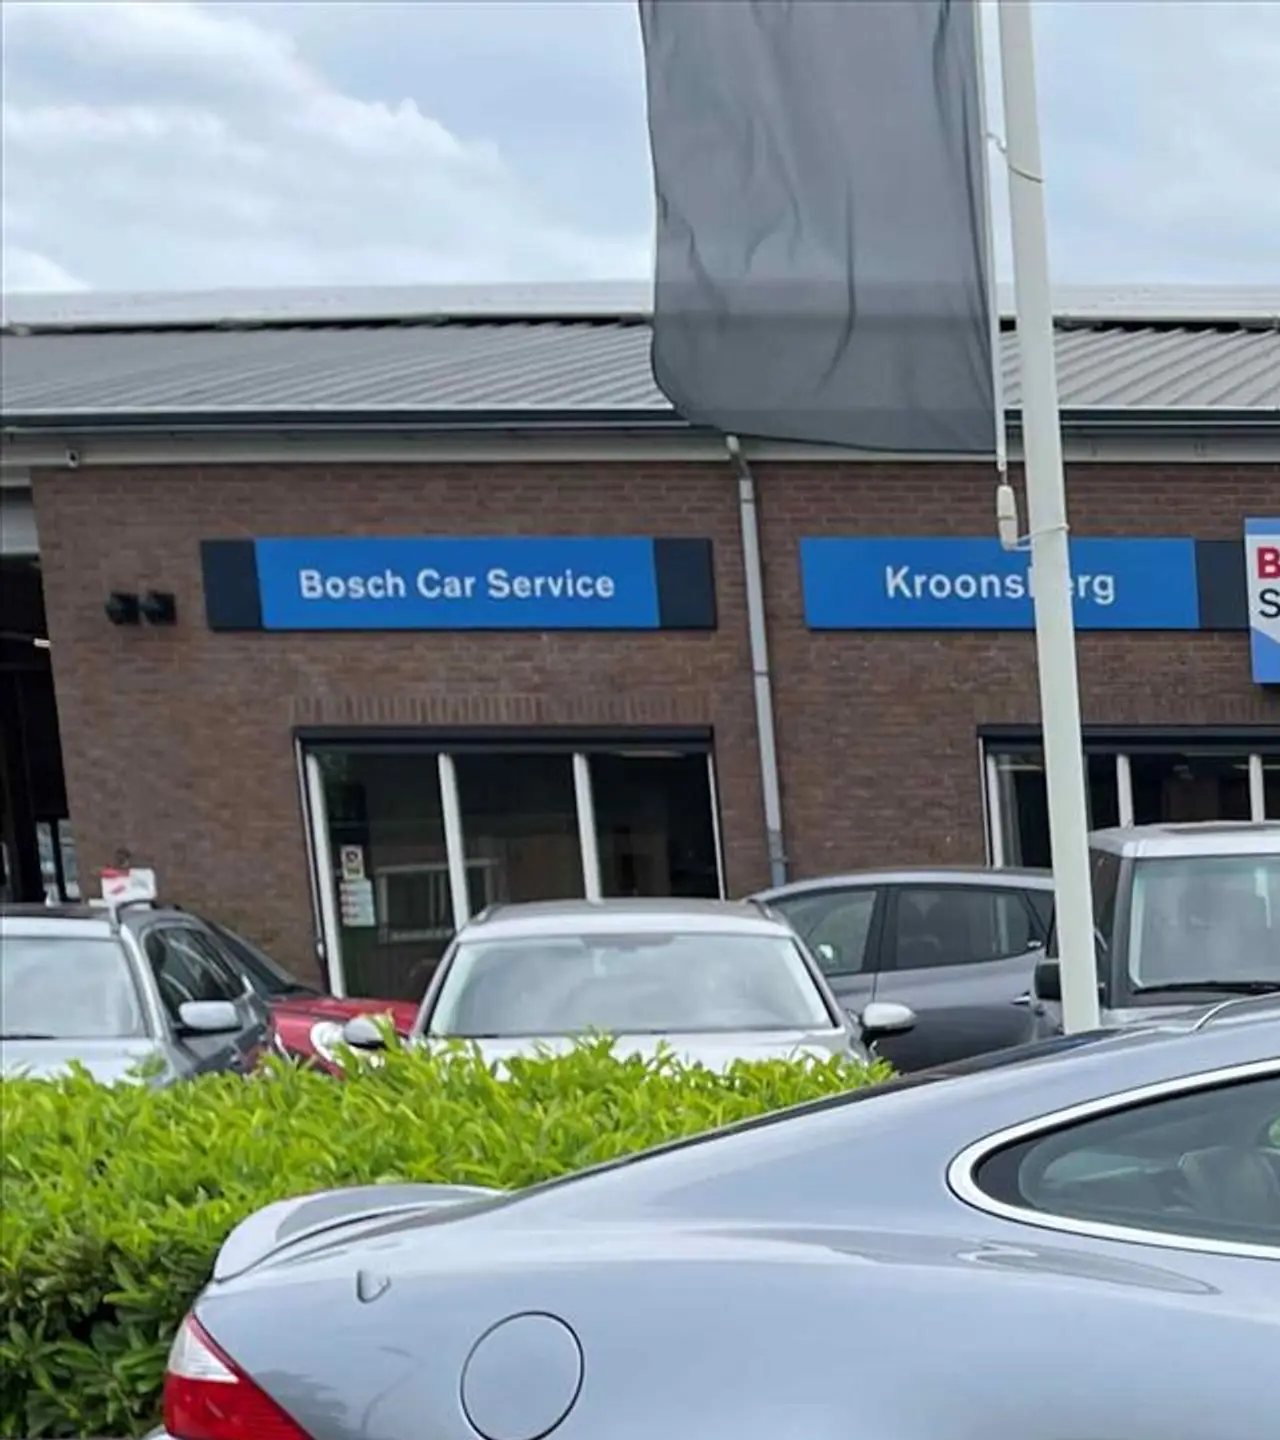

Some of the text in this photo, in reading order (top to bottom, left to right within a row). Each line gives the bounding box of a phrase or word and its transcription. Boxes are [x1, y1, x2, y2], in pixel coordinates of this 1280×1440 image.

[299, 568, 615, 599] Bosch Car Service
[885, 565, 1116, 606] Kroonsrg
